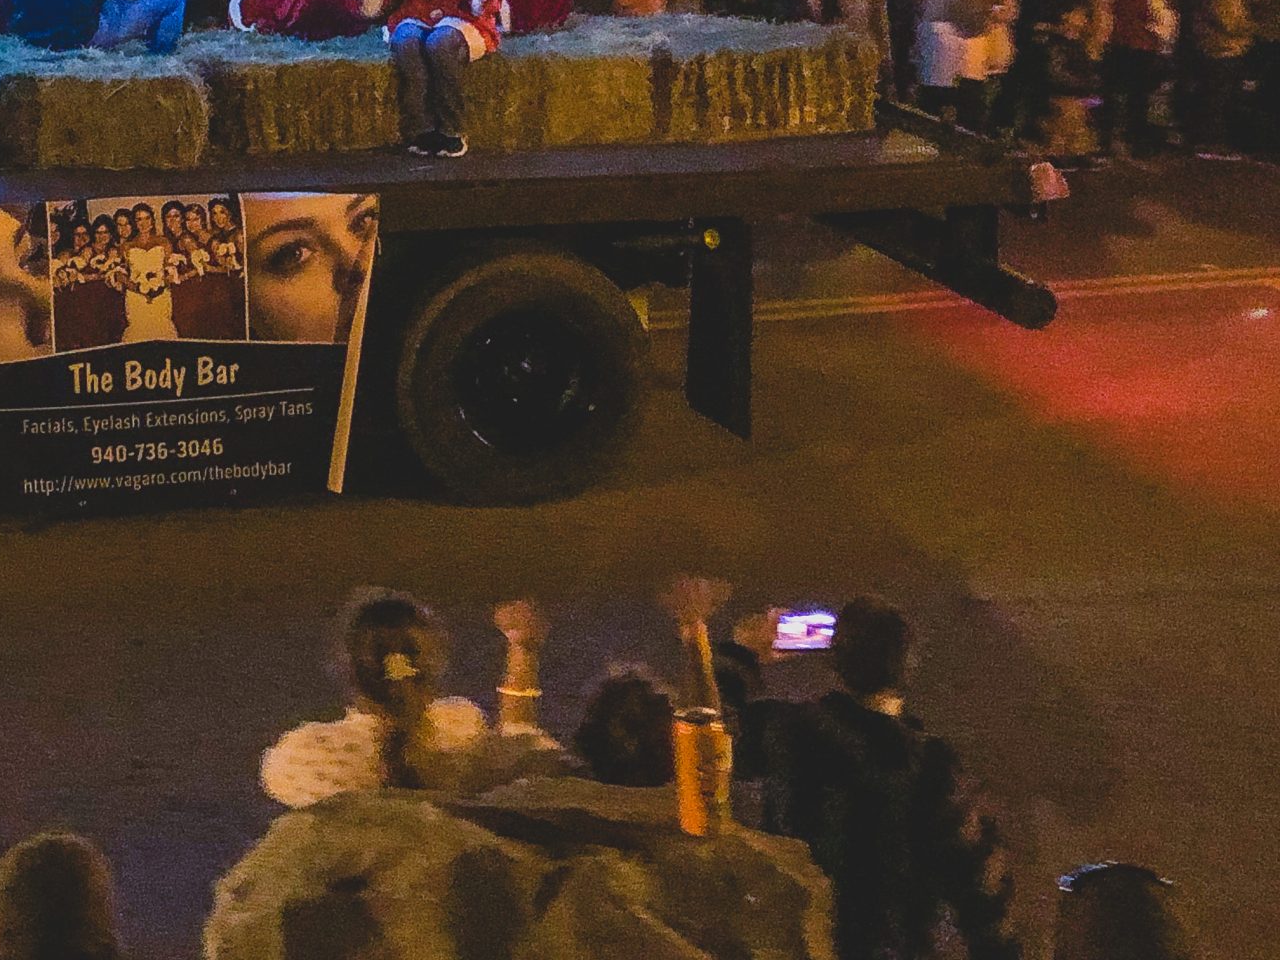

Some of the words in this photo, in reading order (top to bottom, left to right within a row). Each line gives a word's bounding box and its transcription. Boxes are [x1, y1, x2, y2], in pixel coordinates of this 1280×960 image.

[69, 362, 114, 394] The
[124, 358, 186, 398] Body
[196, 356, 240, 386] Bar
[22, 417, 79, 434] Facials,
[83, 414, 140, 436] Eyelash
[146, 407, 230, 427] Extensions,
[235, 402, 274, 422] Spray
[280, 401, 313, 417] Tans
[91, 438, 224, 464] 940-736-3046
[23, 461, 293, 496] http://www.vagaro.com/thebodybar
